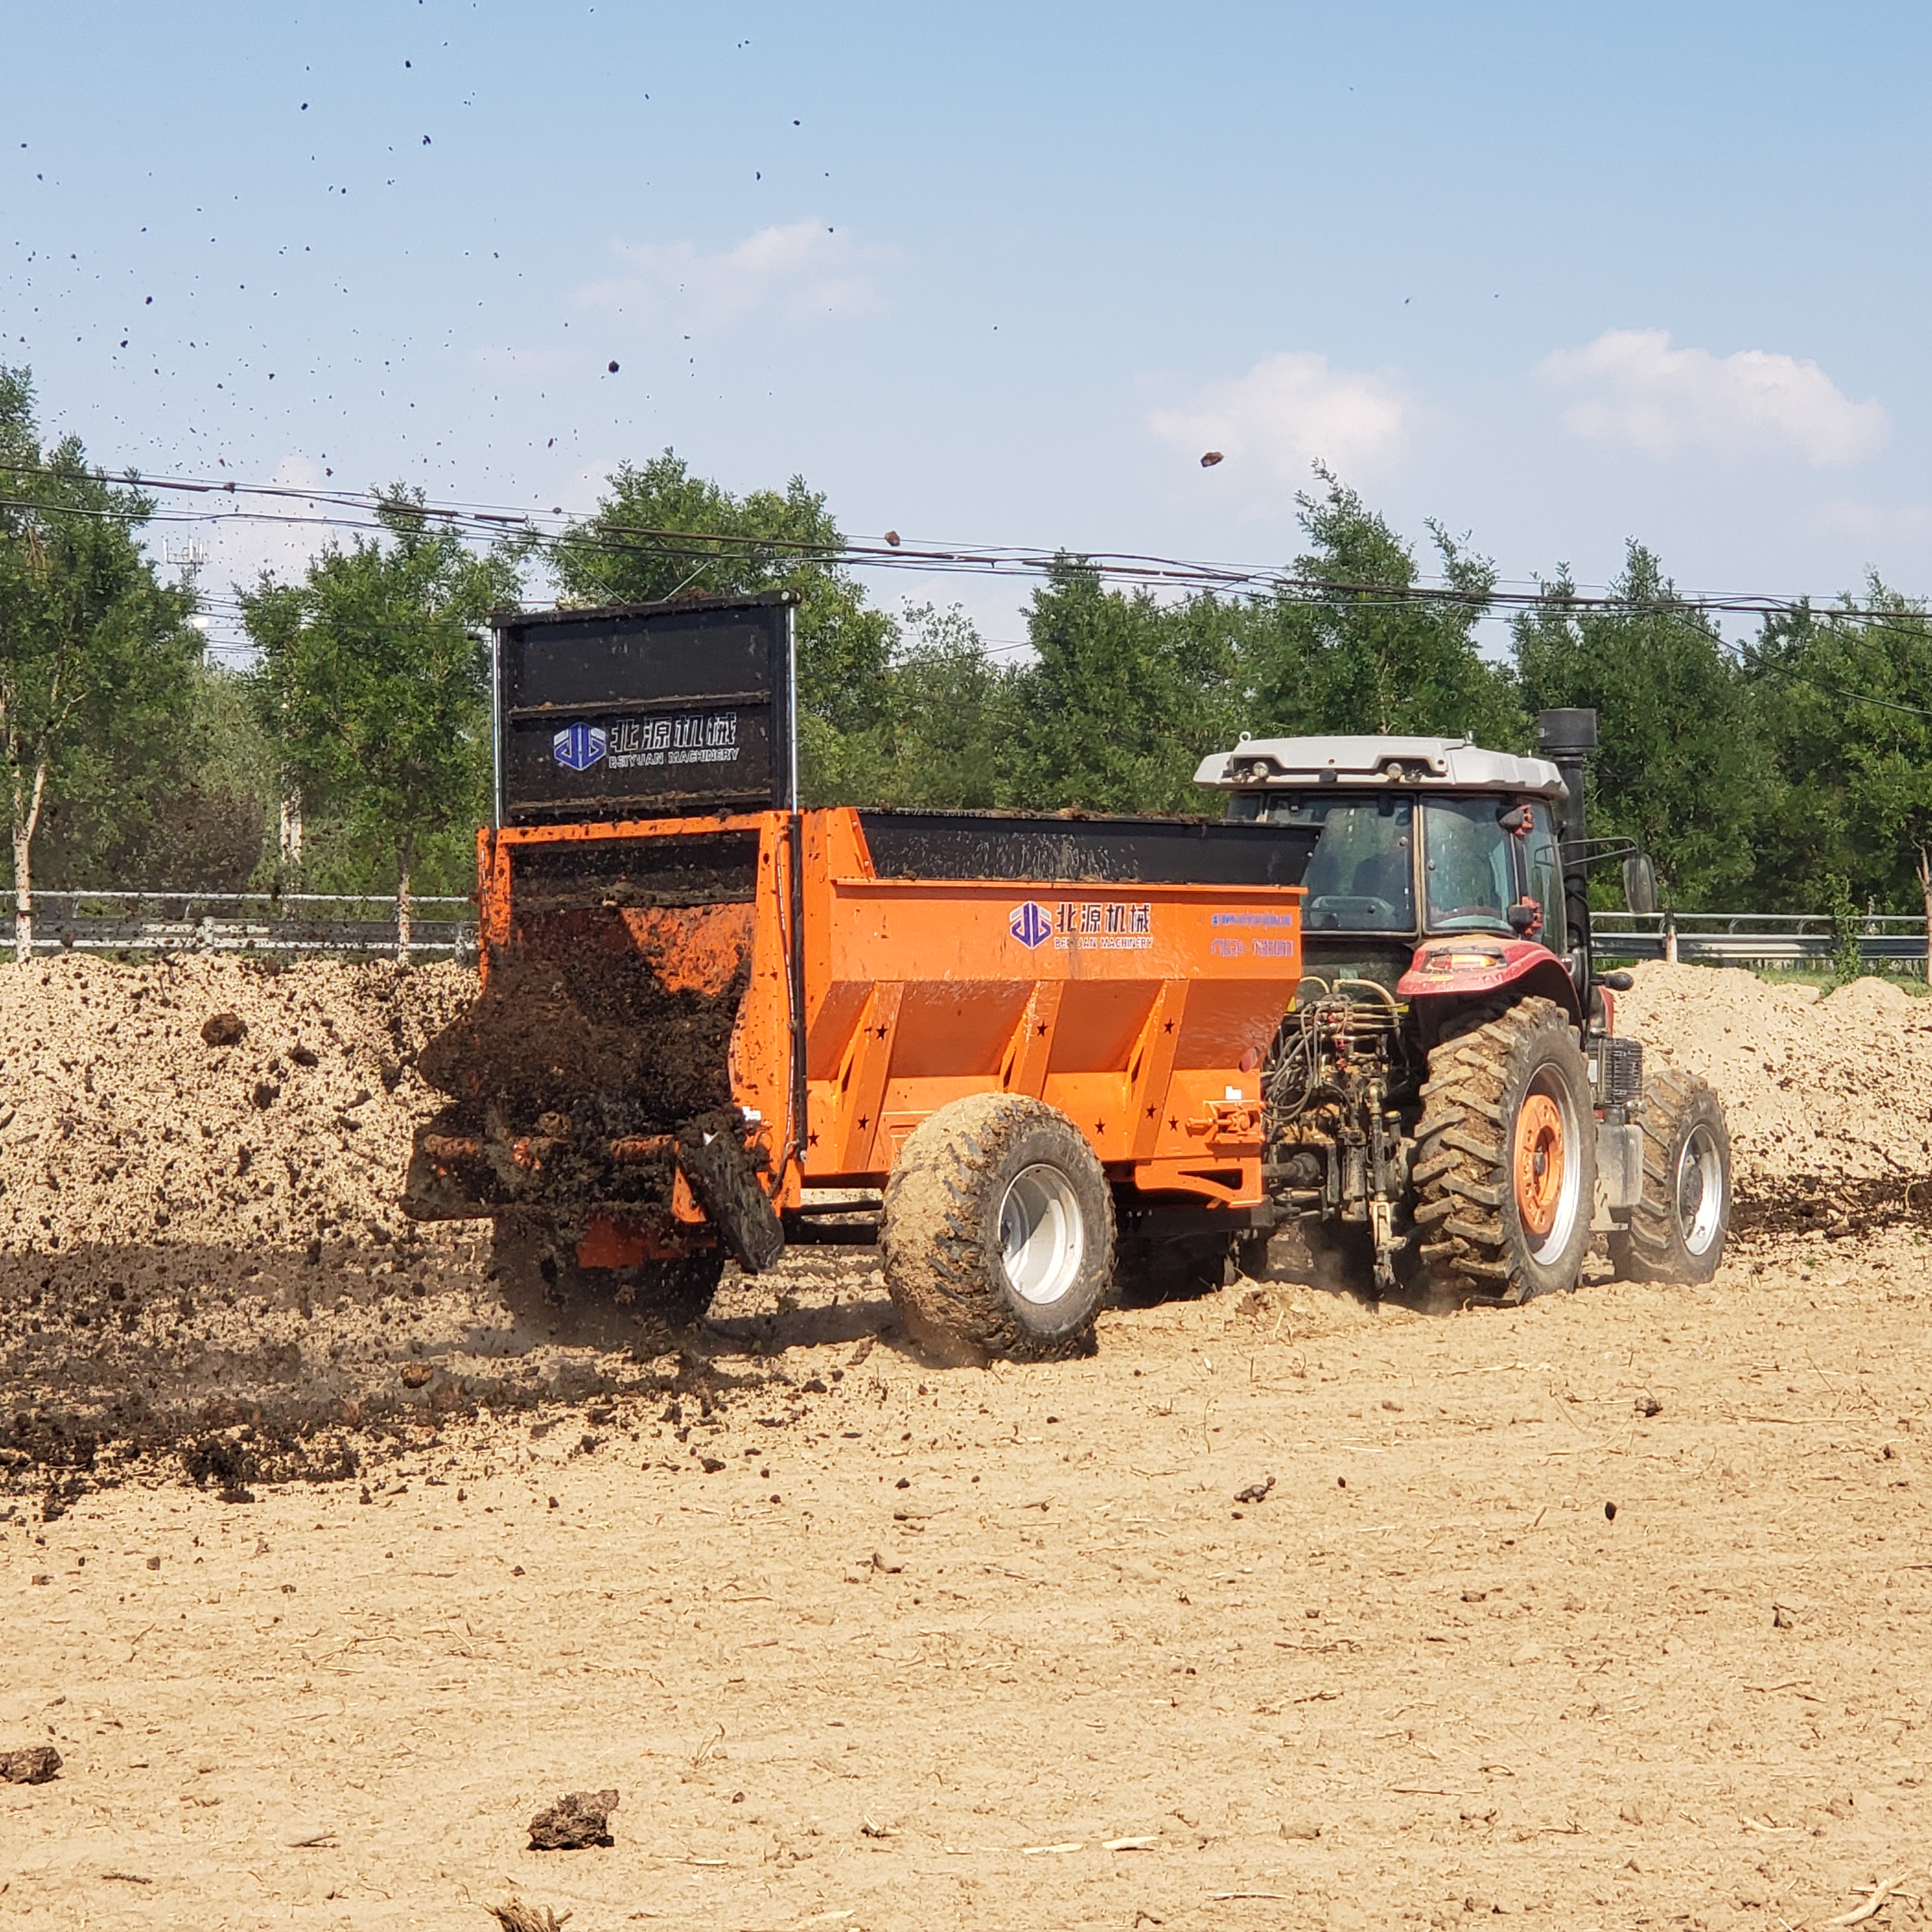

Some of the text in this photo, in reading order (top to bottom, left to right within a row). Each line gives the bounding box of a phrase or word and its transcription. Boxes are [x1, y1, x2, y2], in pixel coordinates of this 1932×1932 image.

[610, 712, 737, 753] 北源机械
[609, 747, 740, 769] BEIYUAN MACHINERY
[1055, 903, 1151, 933] 北源机械
[1054, 937, 1153, 949] BEUAN MACHINERY
